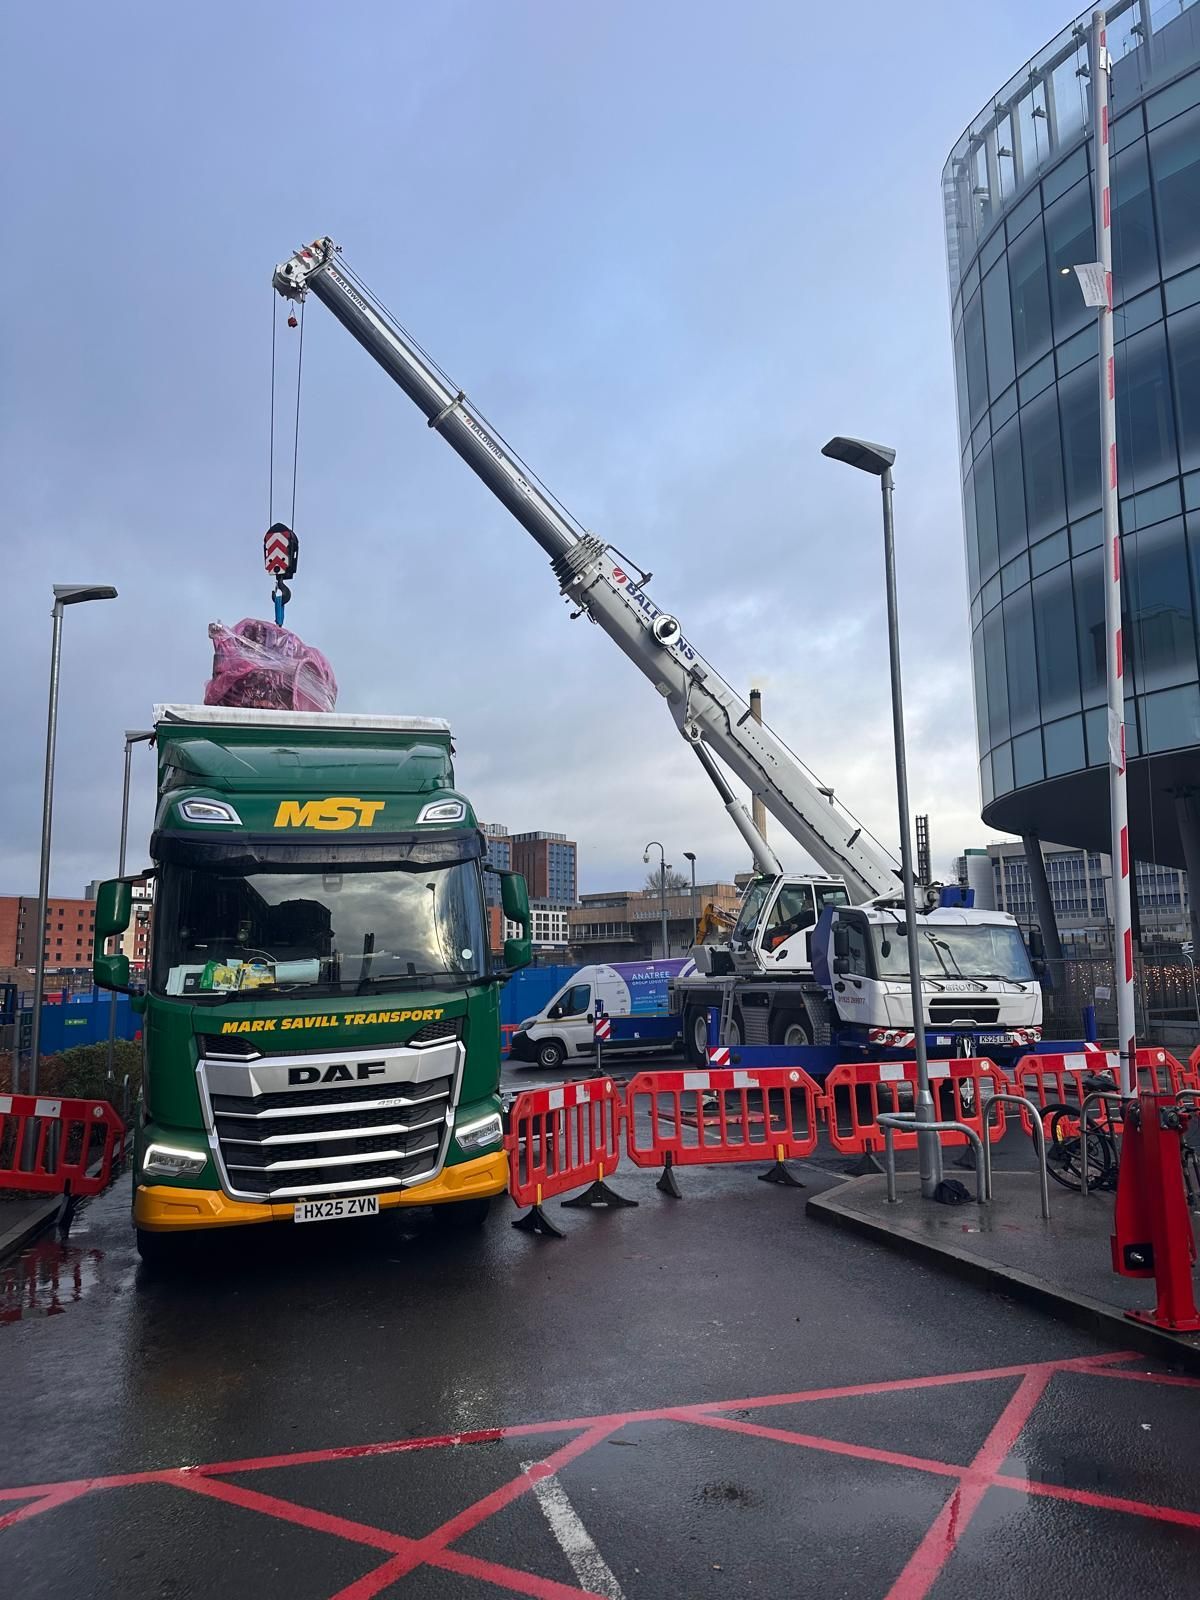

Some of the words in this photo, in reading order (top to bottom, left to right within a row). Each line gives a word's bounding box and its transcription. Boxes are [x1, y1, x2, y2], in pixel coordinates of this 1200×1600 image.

[335, 276, 368, 311] BALDWINS
[470, 423, 503, 460] BALDWINS
[625, 582, 696, 660] BALNS
[273, 797, 386, 831] MST
[631, 971, 672, 981] ANATREE
[221, 1019, 277, 1034] MARK
[280, 1015, 339, 1030] SAVILL
[344, 1009, 444, 1025] TRANSPORT
[288, 1061, 386, 1085] DAF
[304, 1201, 343, 1219] HX25
[347, 1197, 376, 1214] ZVN
